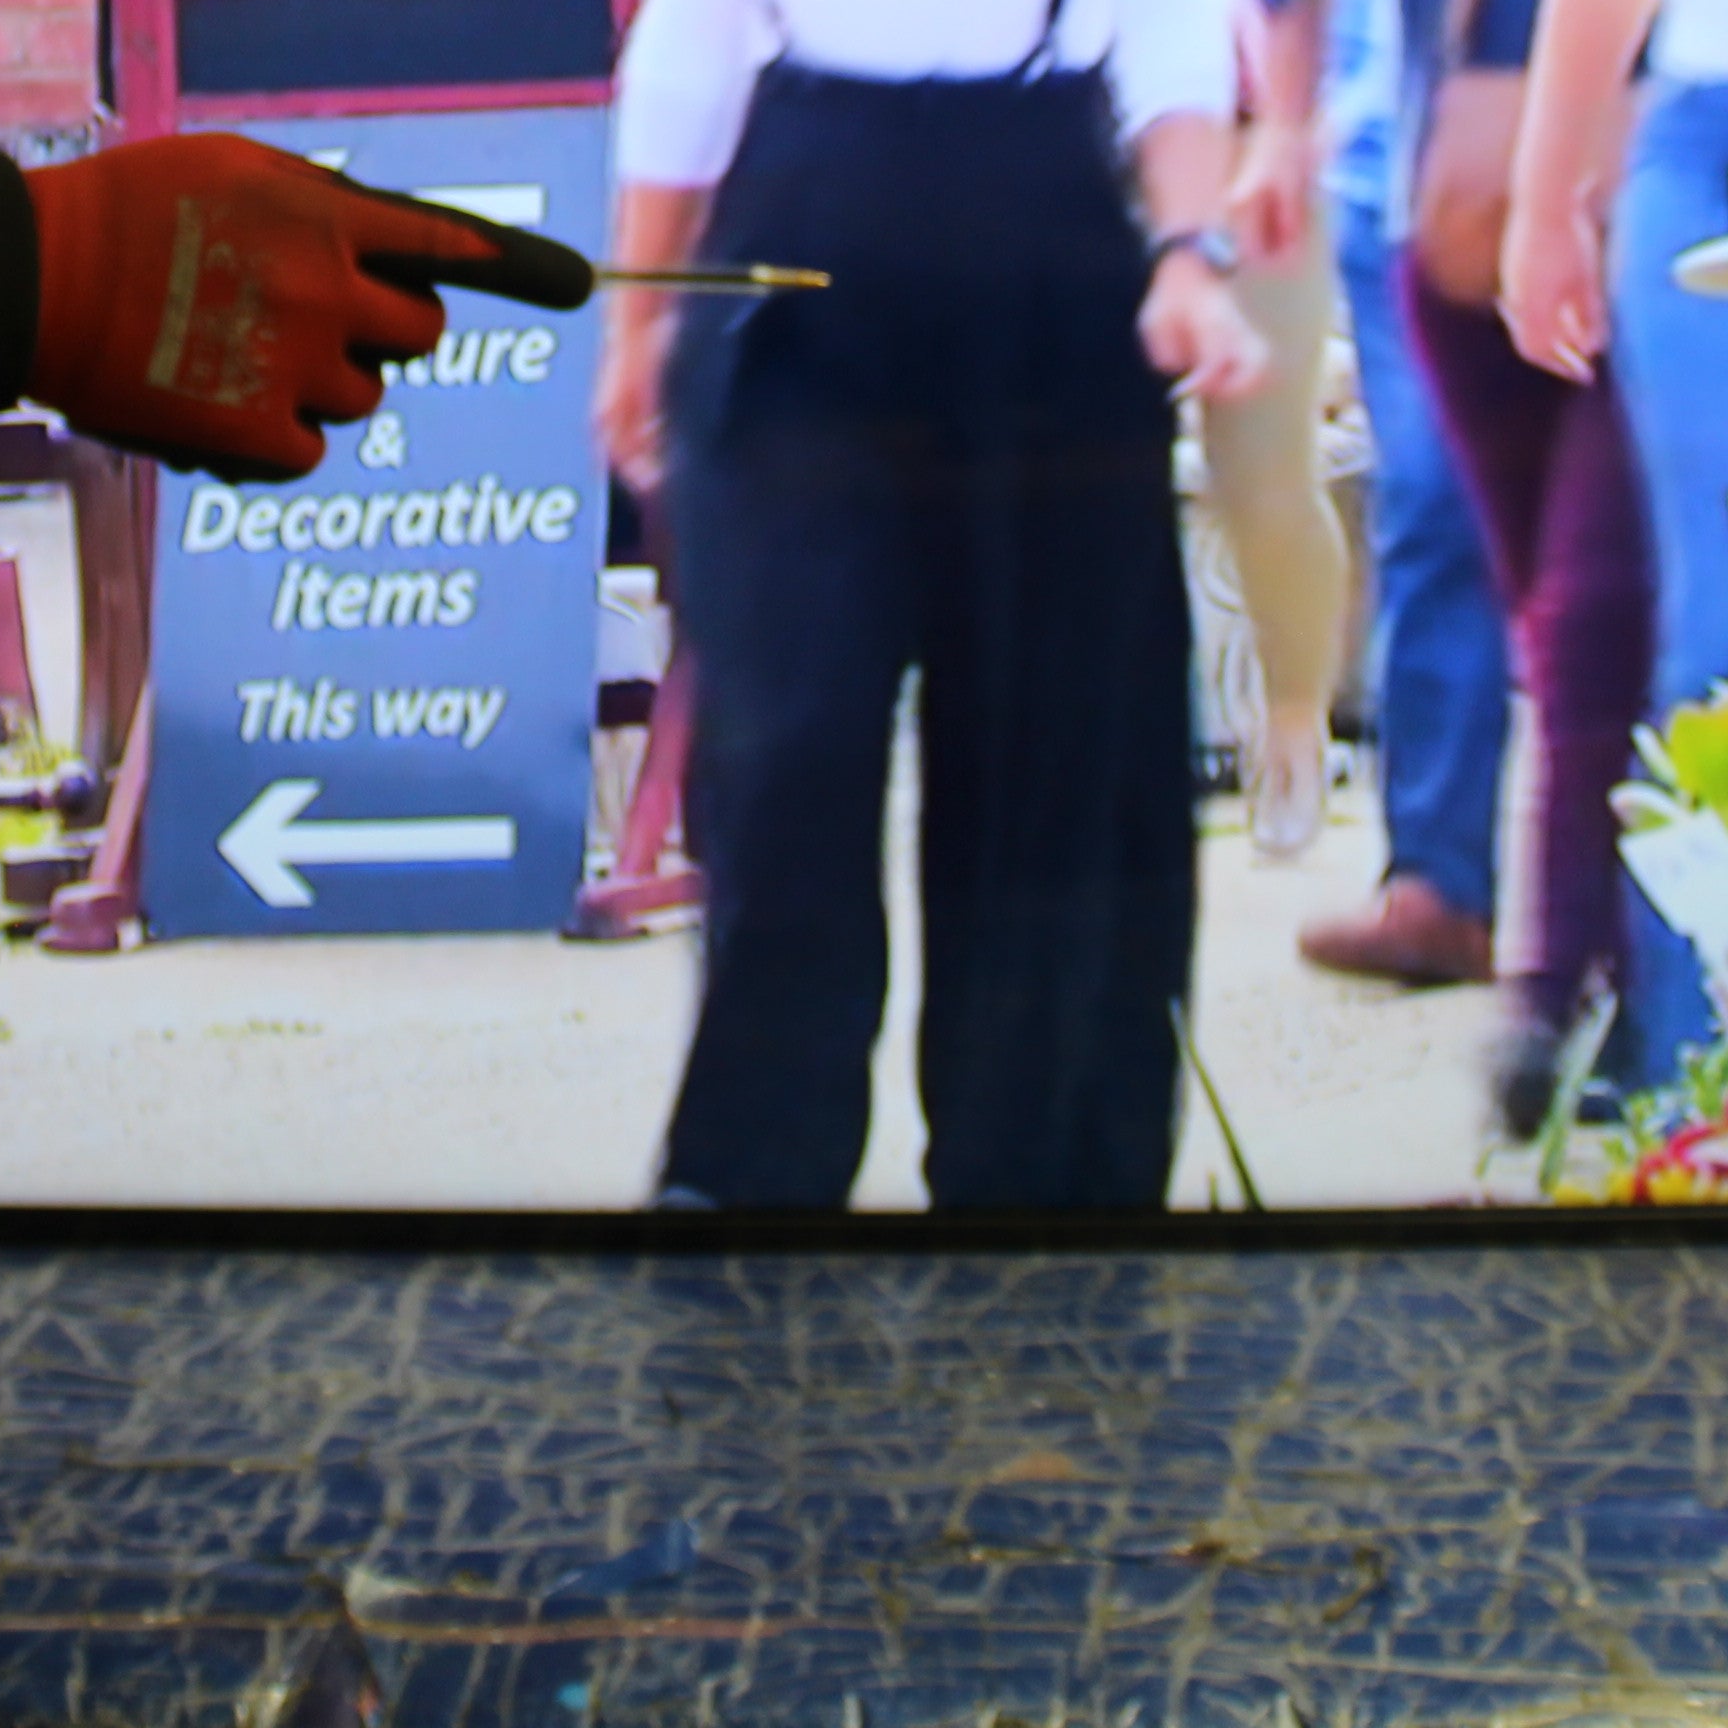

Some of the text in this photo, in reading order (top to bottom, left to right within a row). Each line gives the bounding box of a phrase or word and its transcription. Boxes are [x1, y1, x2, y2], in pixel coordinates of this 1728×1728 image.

[358, 409, 408, 469] &
[181, 472, 579, 555] Decorative
[236, 675, 509, 751] This way
